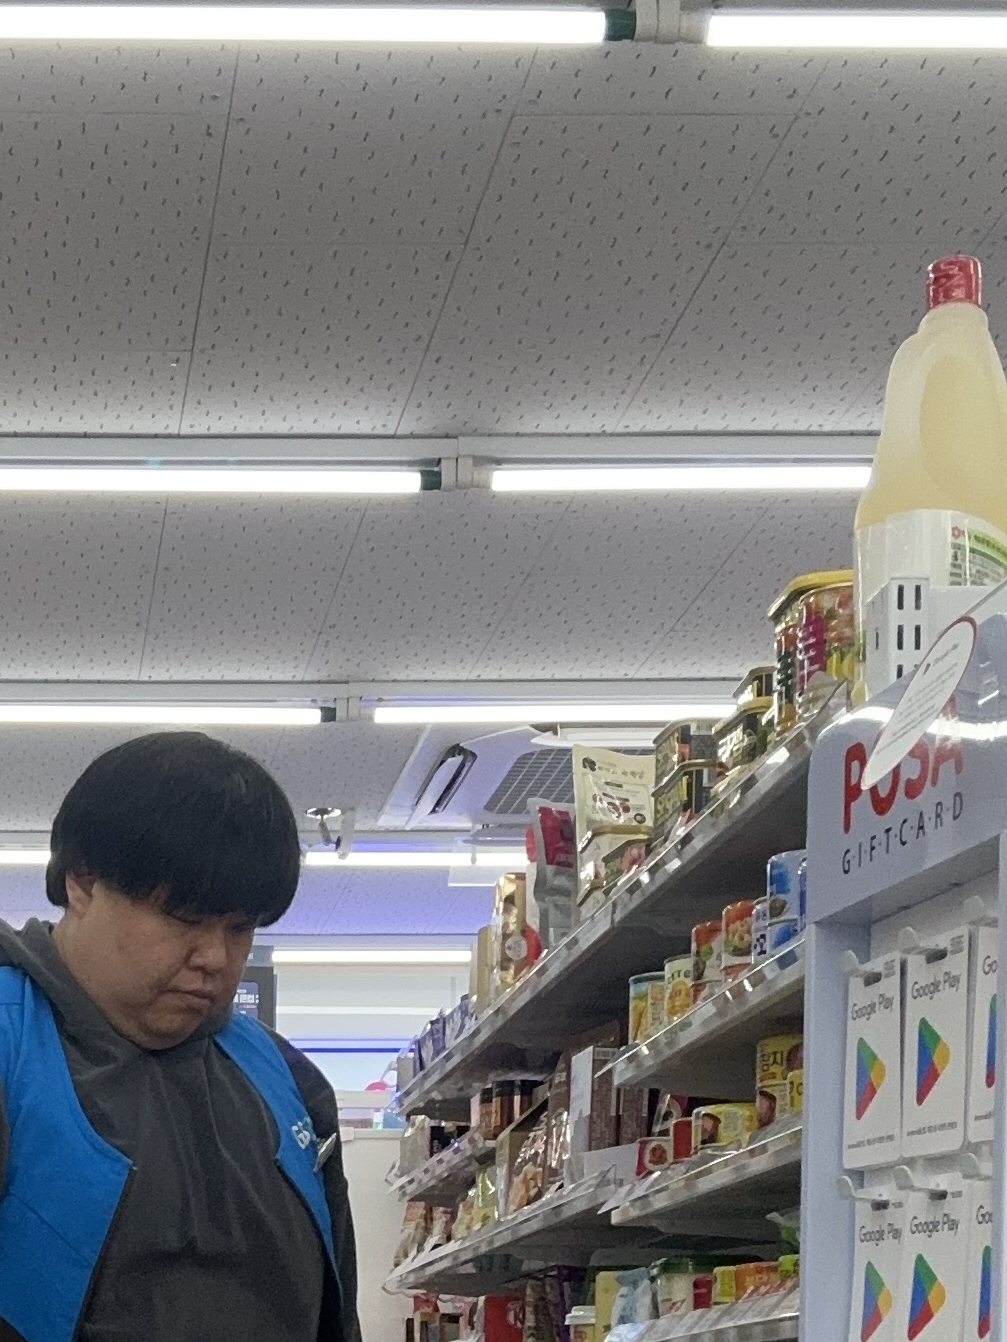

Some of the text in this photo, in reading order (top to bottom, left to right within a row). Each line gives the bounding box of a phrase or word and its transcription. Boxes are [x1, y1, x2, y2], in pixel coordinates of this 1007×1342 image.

[911, 971, 962, 1001] Google Play
[850, 994, 894, 1021] Google Play
[858, 1222, 903, 1246] Google Play
[910, 1213, 960, 1238] Google Play
